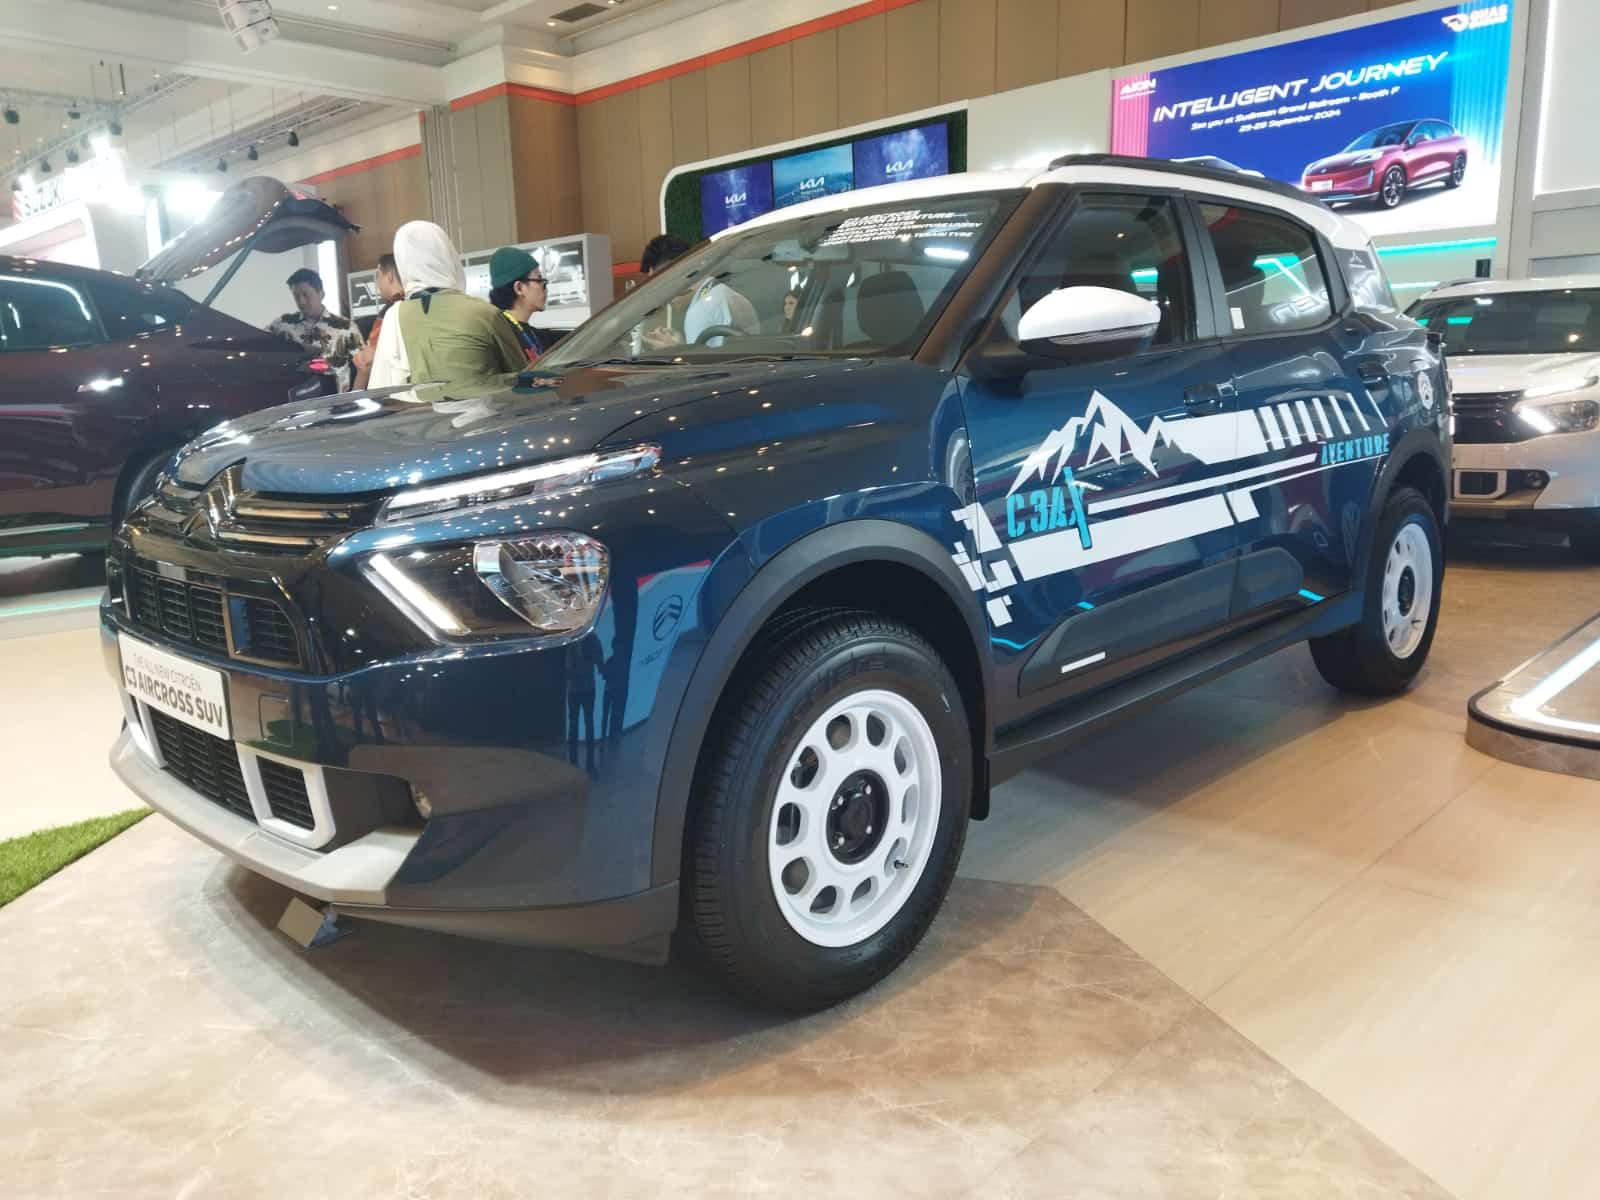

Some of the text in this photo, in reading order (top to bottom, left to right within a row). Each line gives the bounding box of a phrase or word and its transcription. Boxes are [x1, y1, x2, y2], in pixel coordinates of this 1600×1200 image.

[1153, 51, 1448, 122] INTELLIGENT JOURNEY
[886, 159, 914, 173] KIA
[800, 176, 825, 190] KIA
[725, 191, 747, 204] KIA
[138, 671, 194, 716] AIRCROSS
[195, 696, 223, 729] SUV
